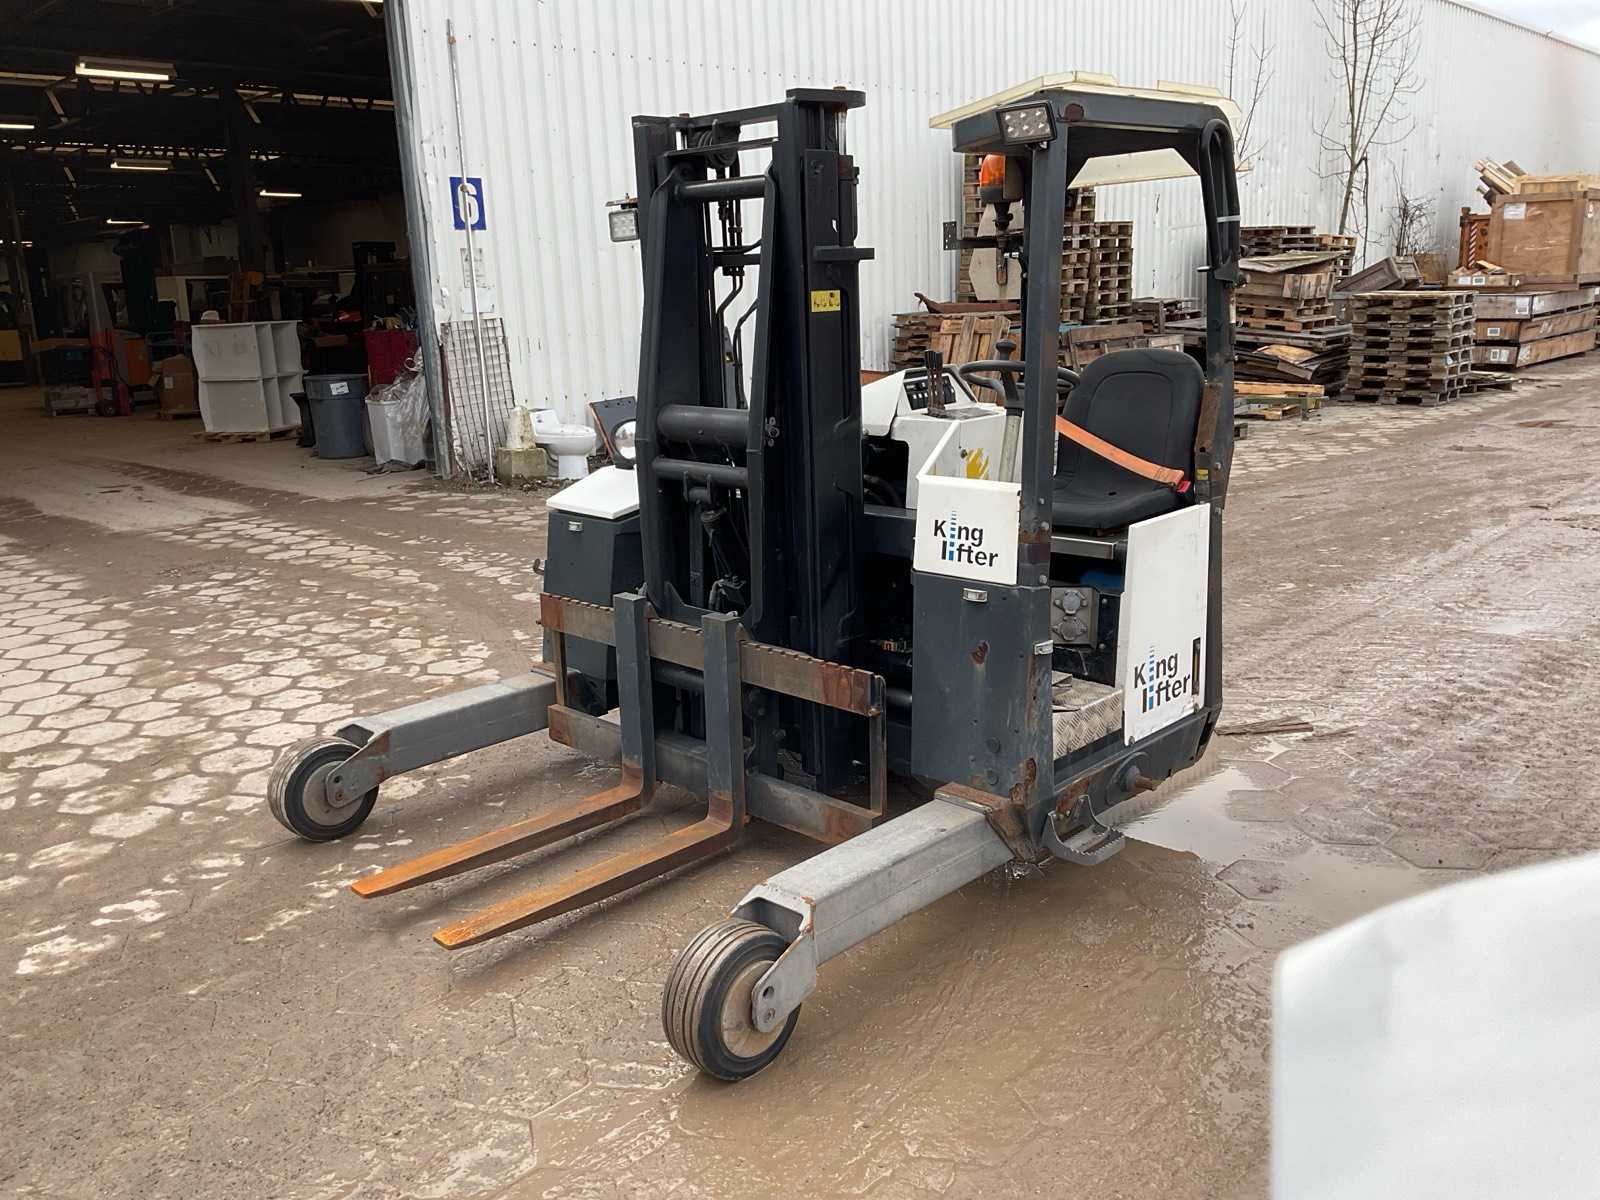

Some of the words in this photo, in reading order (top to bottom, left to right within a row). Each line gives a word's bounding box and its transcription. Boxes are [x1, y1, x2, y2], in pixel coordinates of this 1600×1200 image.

[457, 183, 480, 225] 6
[933, 512, 984, 547] King
[1134, 650, 1178, 689] King
